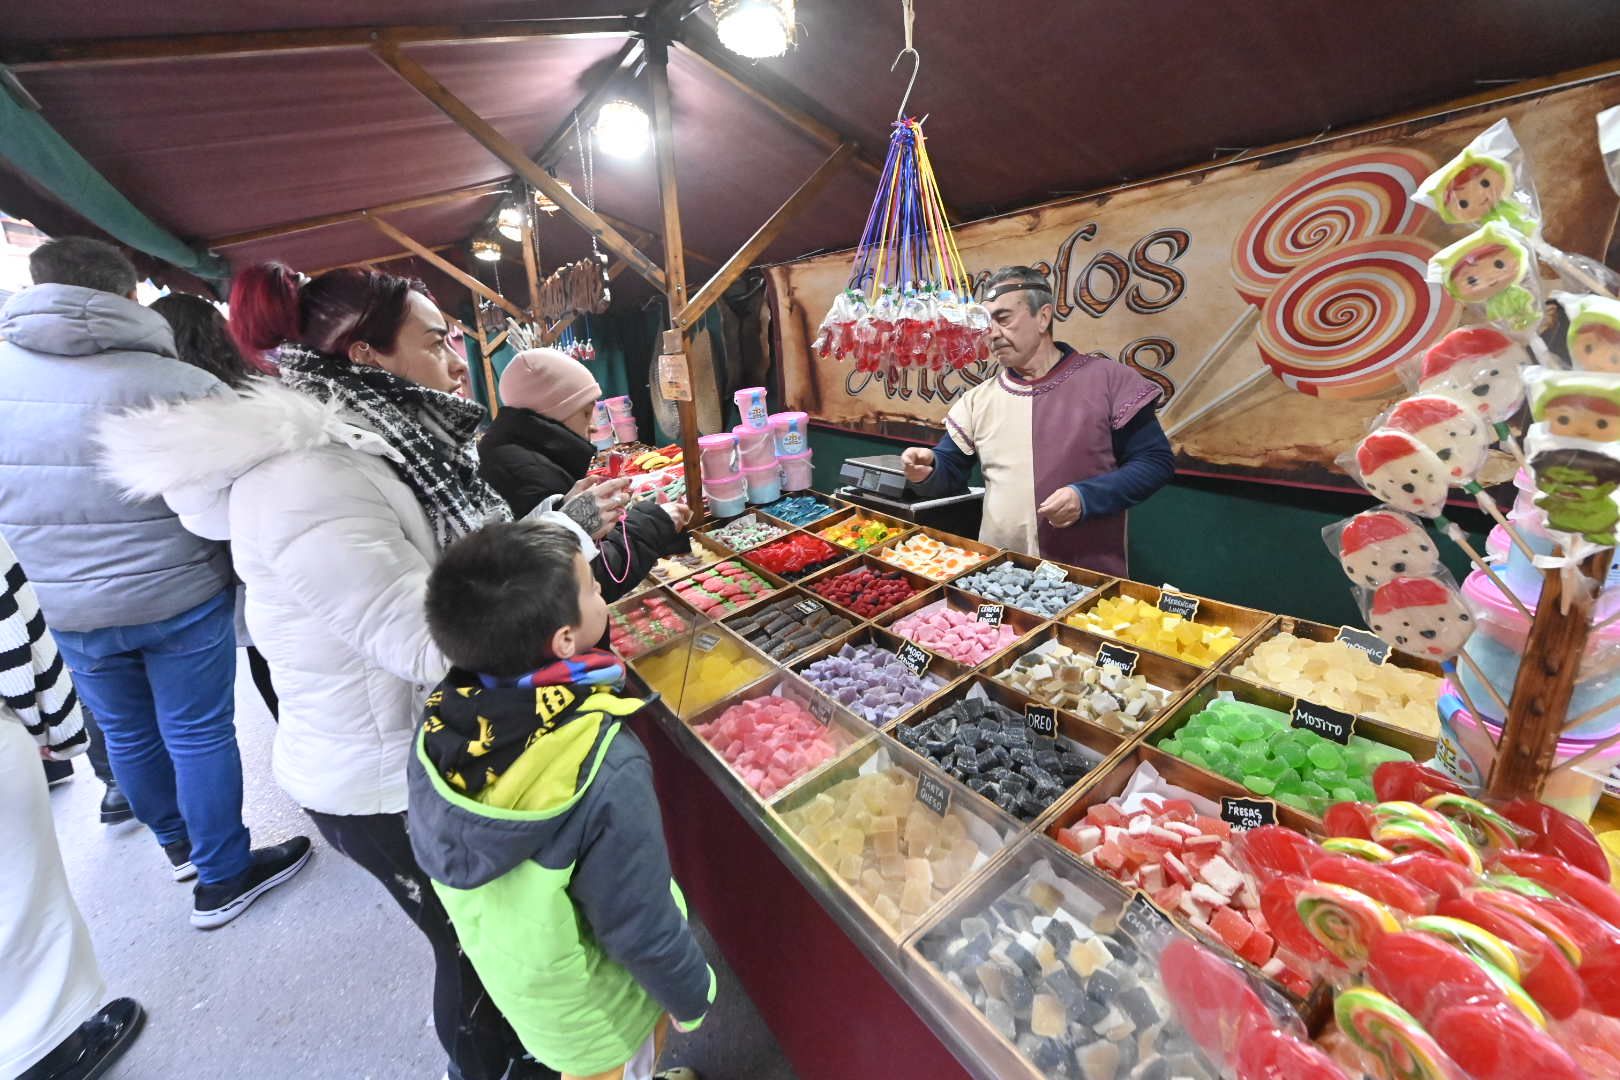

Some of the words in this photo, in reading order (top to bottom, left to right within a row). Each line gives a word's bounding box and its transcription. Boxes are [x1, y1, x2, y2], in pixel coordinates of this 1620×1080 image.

[905, 644, 925, 663] MORA
[1296, 708, 1343, 736] MOJITO
[1227, 801, 1263, 820] FRESAS
[1241, 817, 1262, 828] CON
